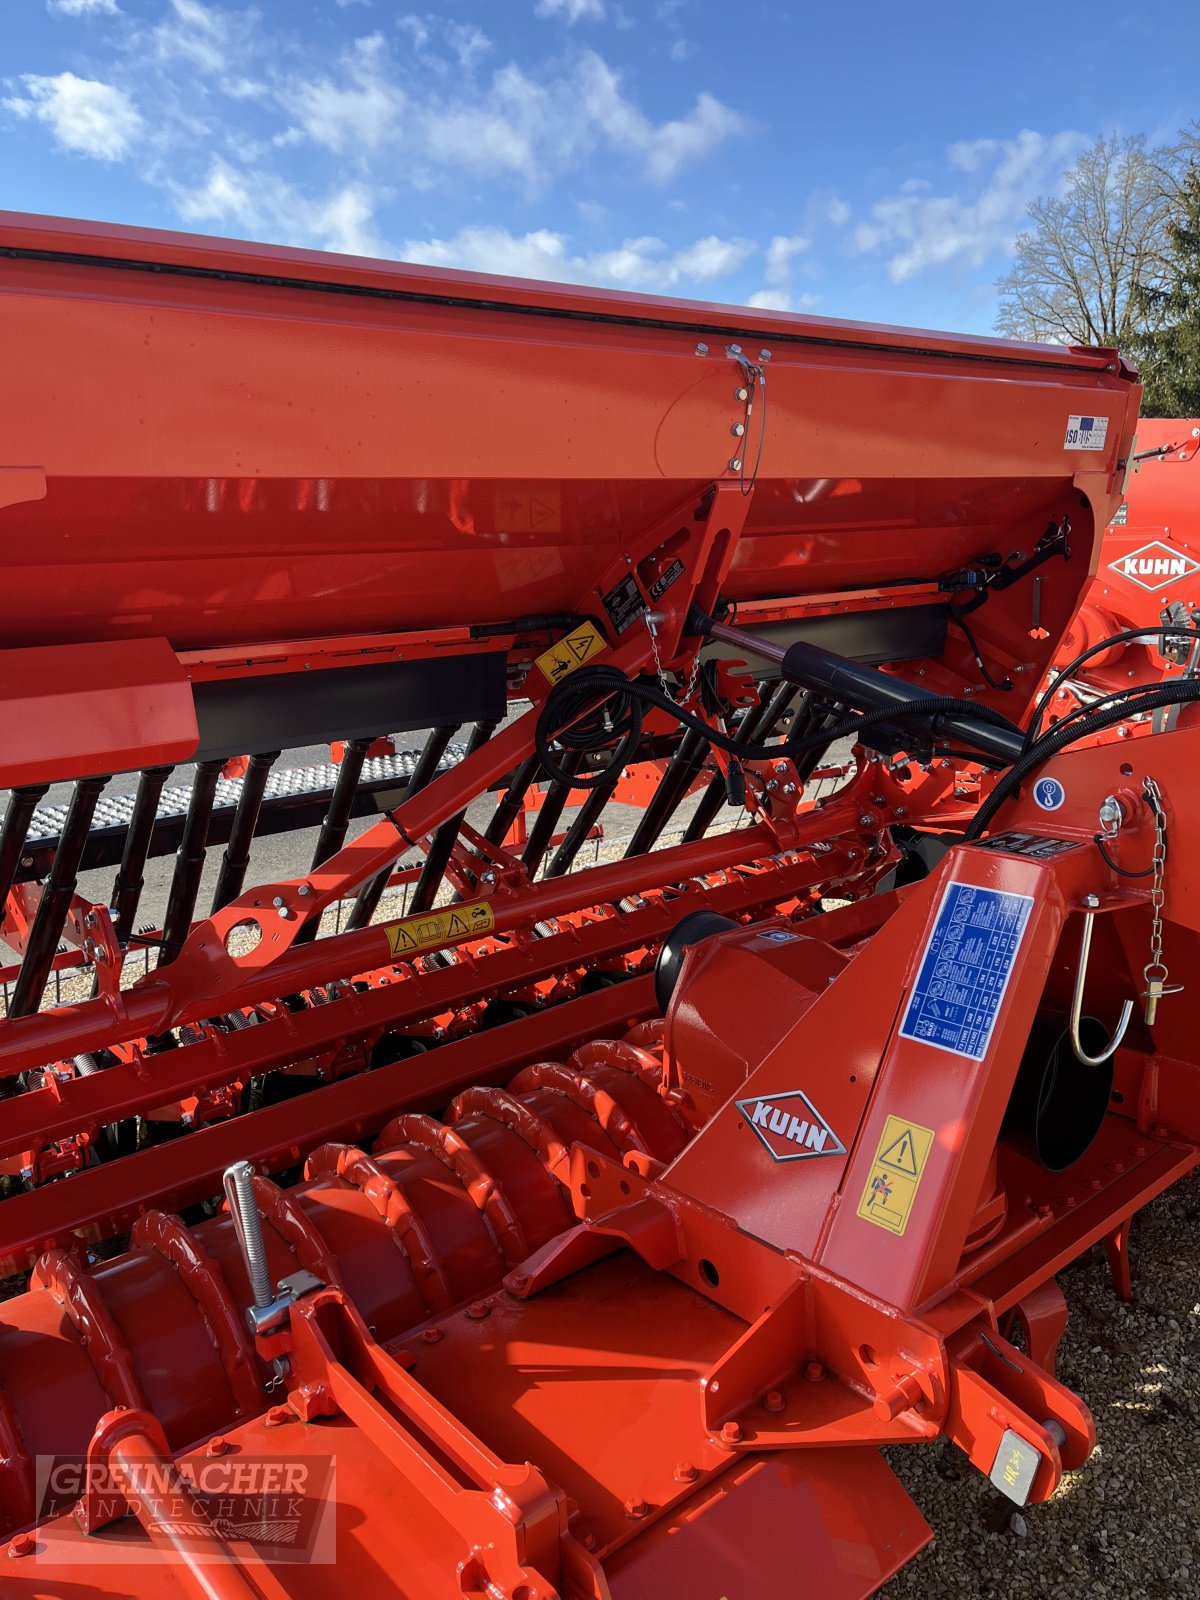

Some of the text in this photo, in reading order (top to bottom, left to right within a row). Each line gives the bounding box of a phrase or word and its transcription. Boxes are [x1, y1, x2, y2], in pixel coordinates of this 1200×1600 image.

[1124, 558, 1186, 575] KUHN
[926, 1021, 934, 1036] MAXI
[984, 1016, 992, 1028] 1000
[751, 1101, 828, 1154] KUHN
